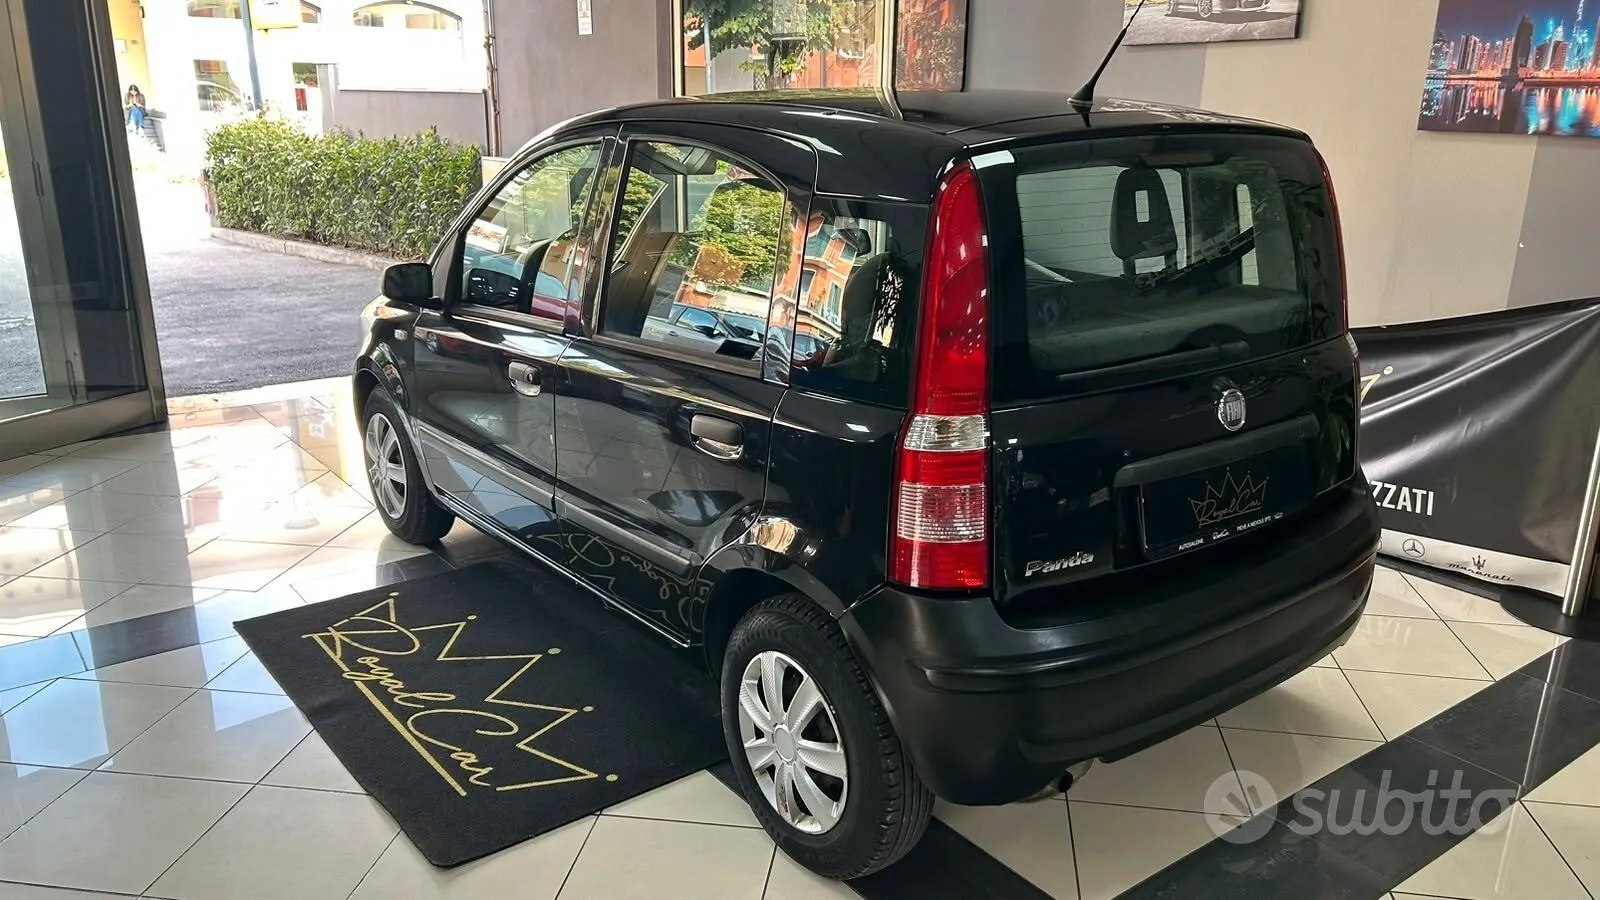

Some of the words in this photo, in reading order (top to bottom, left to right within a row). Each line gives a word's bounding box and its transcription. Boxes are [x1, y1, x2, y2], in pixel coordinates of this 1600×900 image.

[1024, 551, 1095, 577] Panda
[310, 616, 456, 708] Royal
[407, 708, 519, 786] Car
